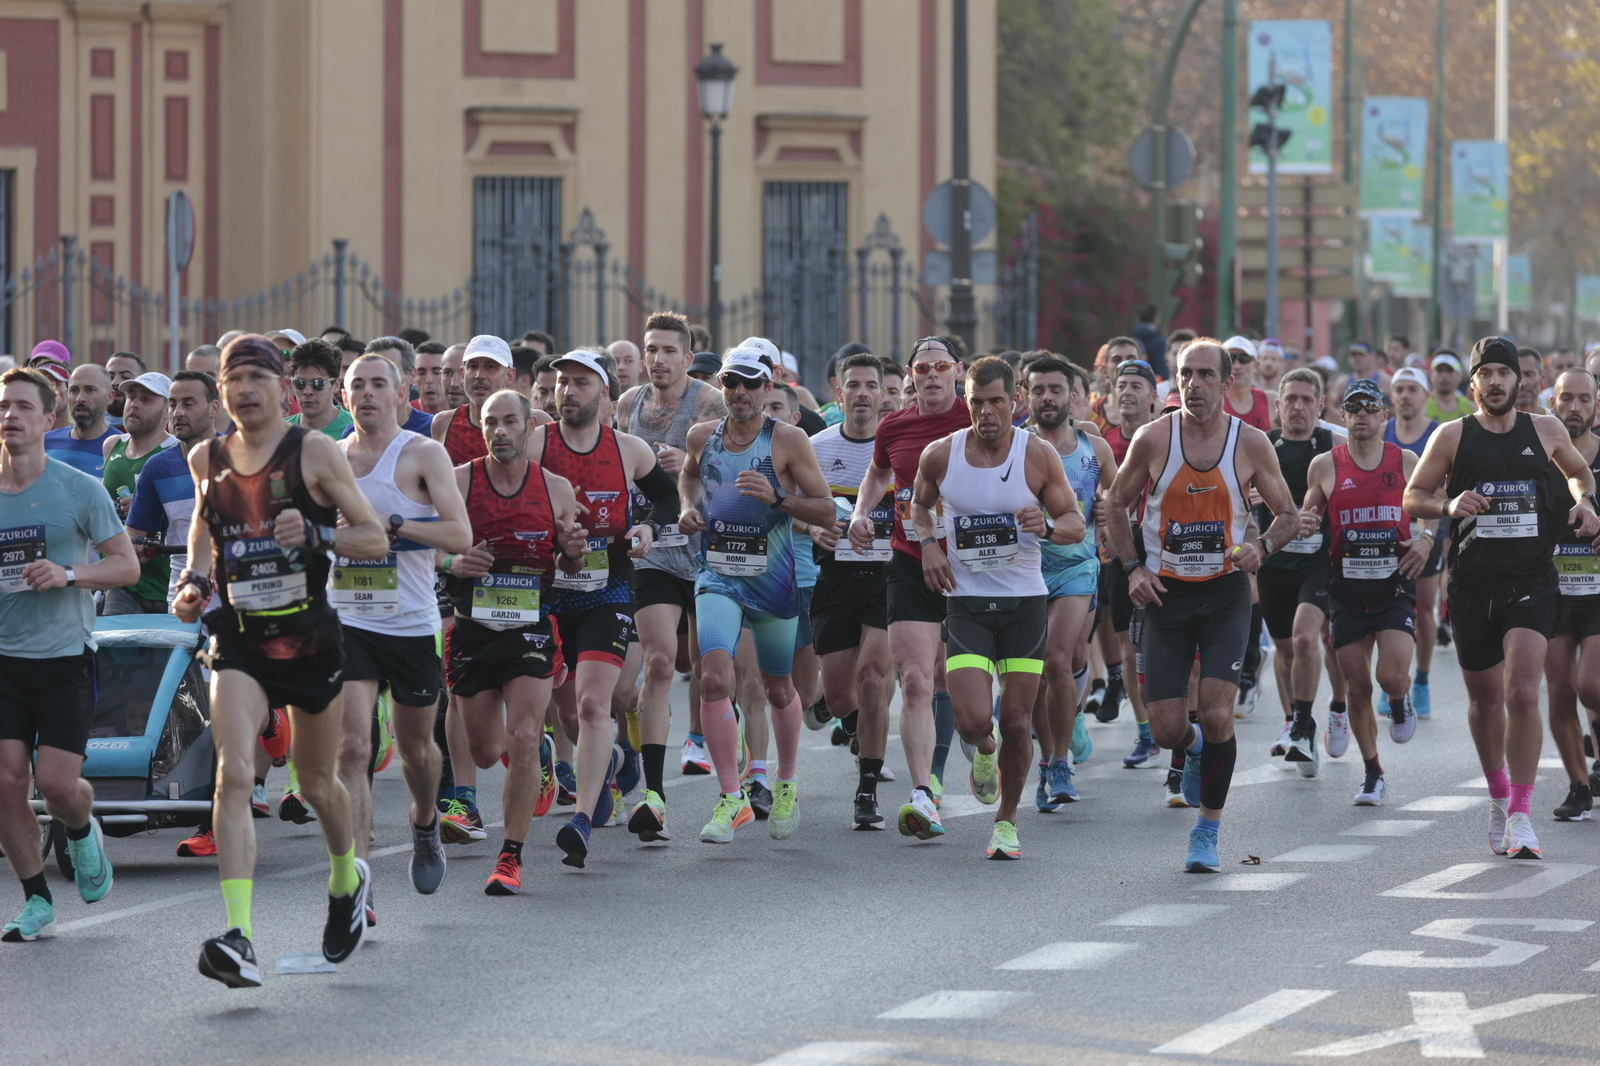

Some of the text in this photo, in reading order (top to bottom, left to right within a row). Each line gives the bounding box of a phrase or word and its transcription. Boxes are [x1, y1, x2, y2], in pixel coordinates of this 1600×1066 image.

[1497, 484, 1529, 493] ZURICH
[1498, 502, 1519, 511] 1785
[974, 516, 1008, 526] ZURICH
[1339, 509, 1351, 525] CD
[726, 524, 760, 533] ZURICH
[1183, 524, 1218, 534] ZURICH
[0, 528, 37, 542] ZURICH
[975, 534, 998, 545] 3136
[1359, 532, 1391, 540] ZURICH
[726, 541, 747, 551] 1772
[1181, 541, 1203, 552] 2965
[1562, 546, 1594, 554] ZURICH
[2, 550, 25, 563] 2973
[978, 548, 997, 557] ALEX
[1360, 547, 1379, 556] 2219
[725, 555, 746, 563] ROMU
[1179, 554, 1205, 563] DANILO
[250, 561, 278, 577] 2402
[1563, 563, 1582, 571] 1226
[251, 579, 283, 592] PERIKO
[353, 576, 373, 587] 1081
[496, 577, 533, 587] ZURICH
[353, 592, 373, 601] SEAN
[496, 595, 518, 606] 1262
[491, 610, 521, 619] GARZON
[86, 741, 131, 751] OZER
